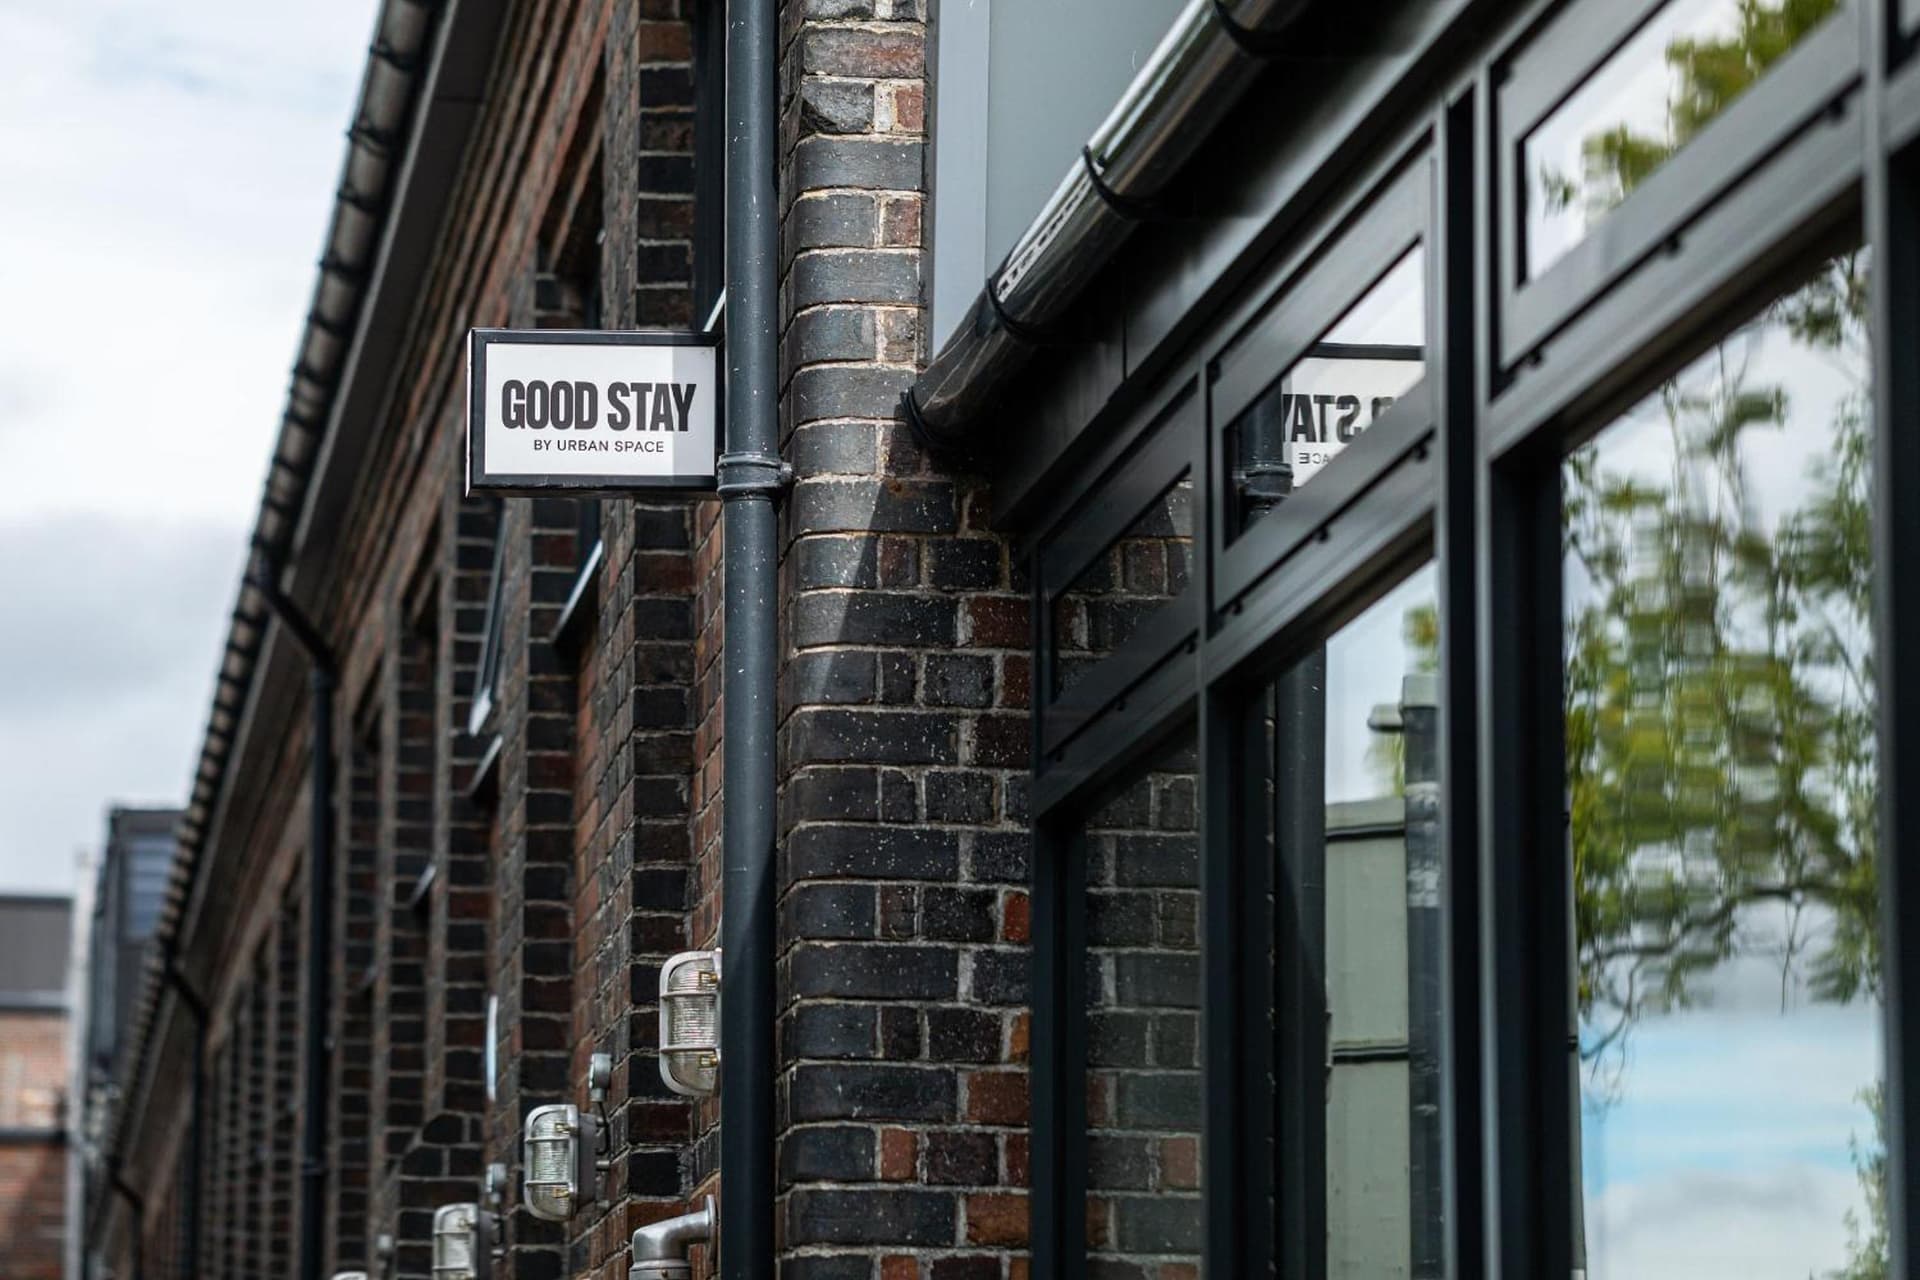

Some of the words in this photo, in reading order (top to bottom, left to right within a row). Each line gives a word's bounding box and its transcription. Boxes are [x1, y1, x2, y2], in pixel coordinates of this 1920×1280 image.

[501, 379, 598, 430] GOOD
[607, 381, 697, 432] STAY
[534, 439, 552, 450] BY
[557, 440, 609, 452] URBAN
[614, 440, 664, 453] SPACE
